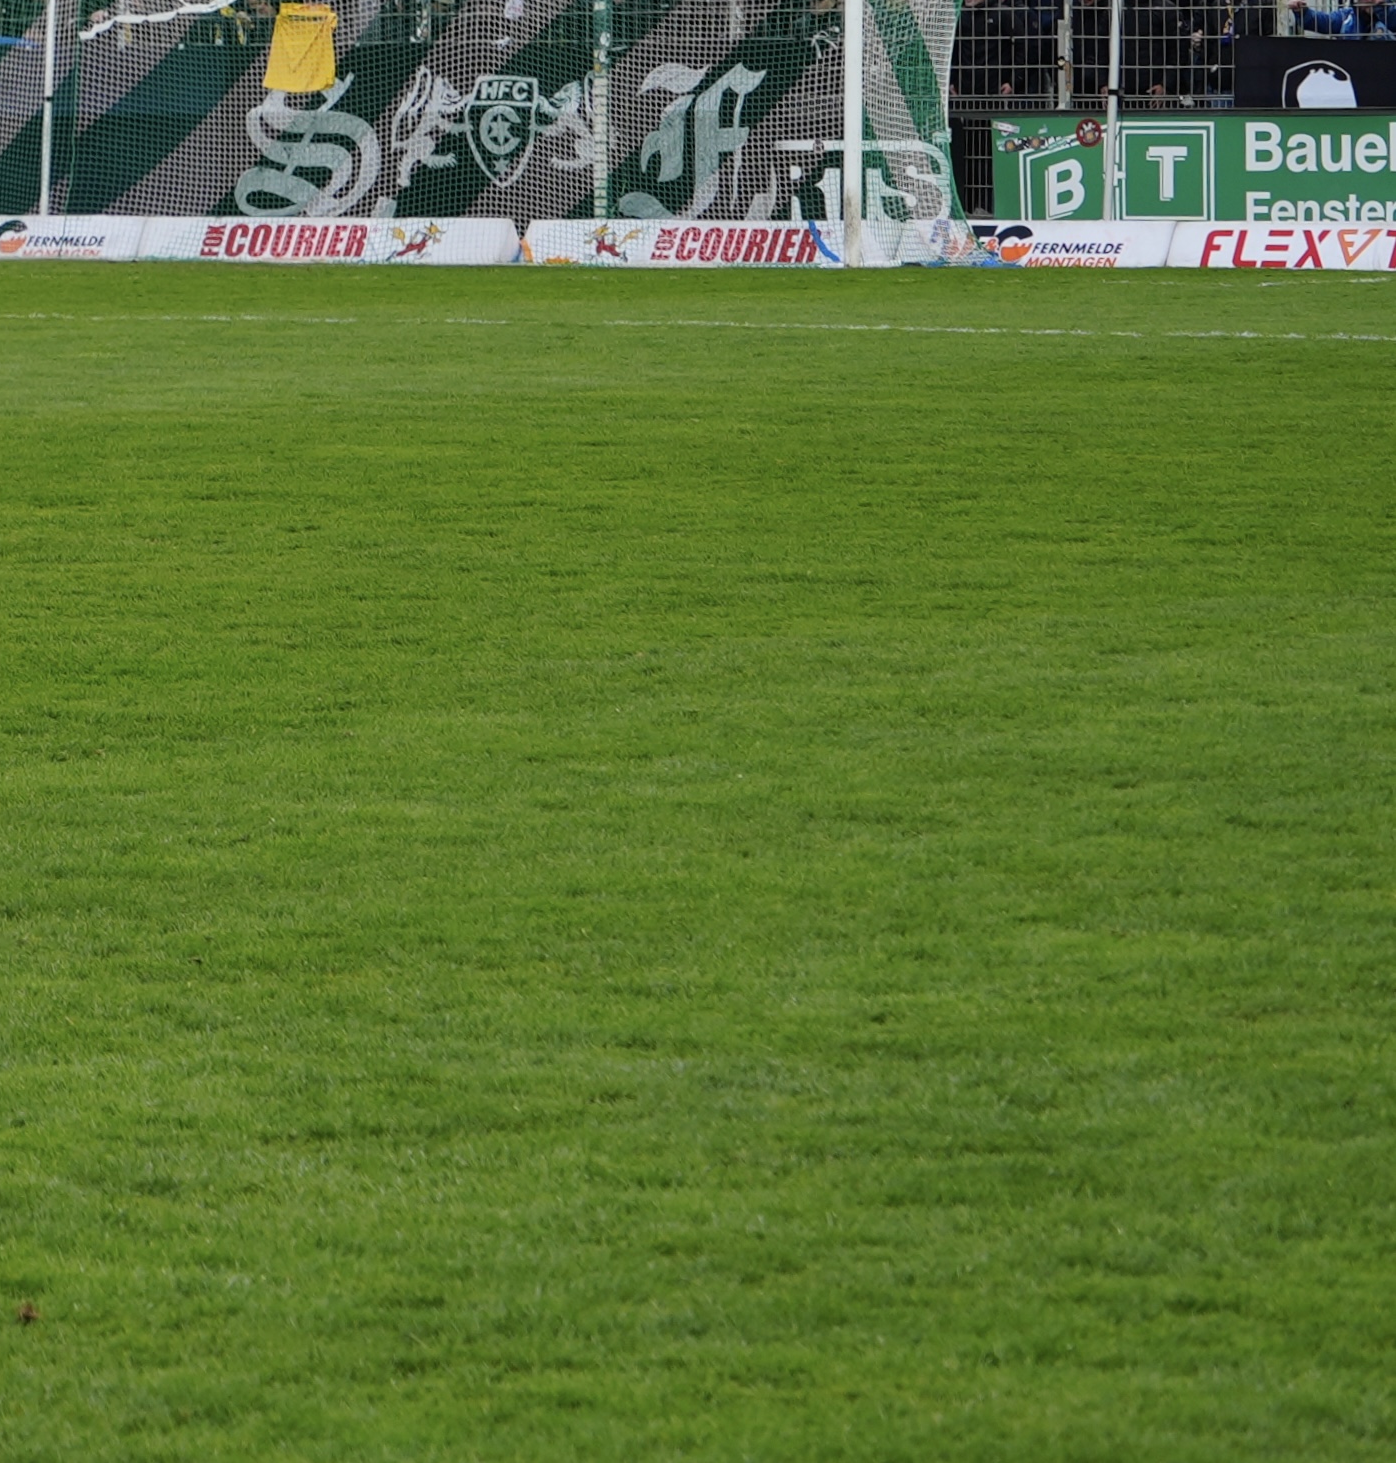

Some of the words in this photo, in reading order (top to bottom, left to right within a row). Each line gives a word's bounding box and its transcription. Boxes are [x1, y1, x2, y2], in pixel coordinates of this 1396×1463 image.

[479, 80, 528, 100] HFC
[1045, 158, 1086, 220] B
[1146, 146, 1189, 202] T
[1245, 191, 1396, 222] Fenster
[26, 235, 106, 248] FERNMELDE
[225, 223, 368, 257] COURIER
[675, 226, 821, 263] COURIER
[1032, 242, 1125, 255] FERNMELDE
[1199, 229, 1332, 269] FLEX
[1024, 256, 1118, 268] MONTAGEN
